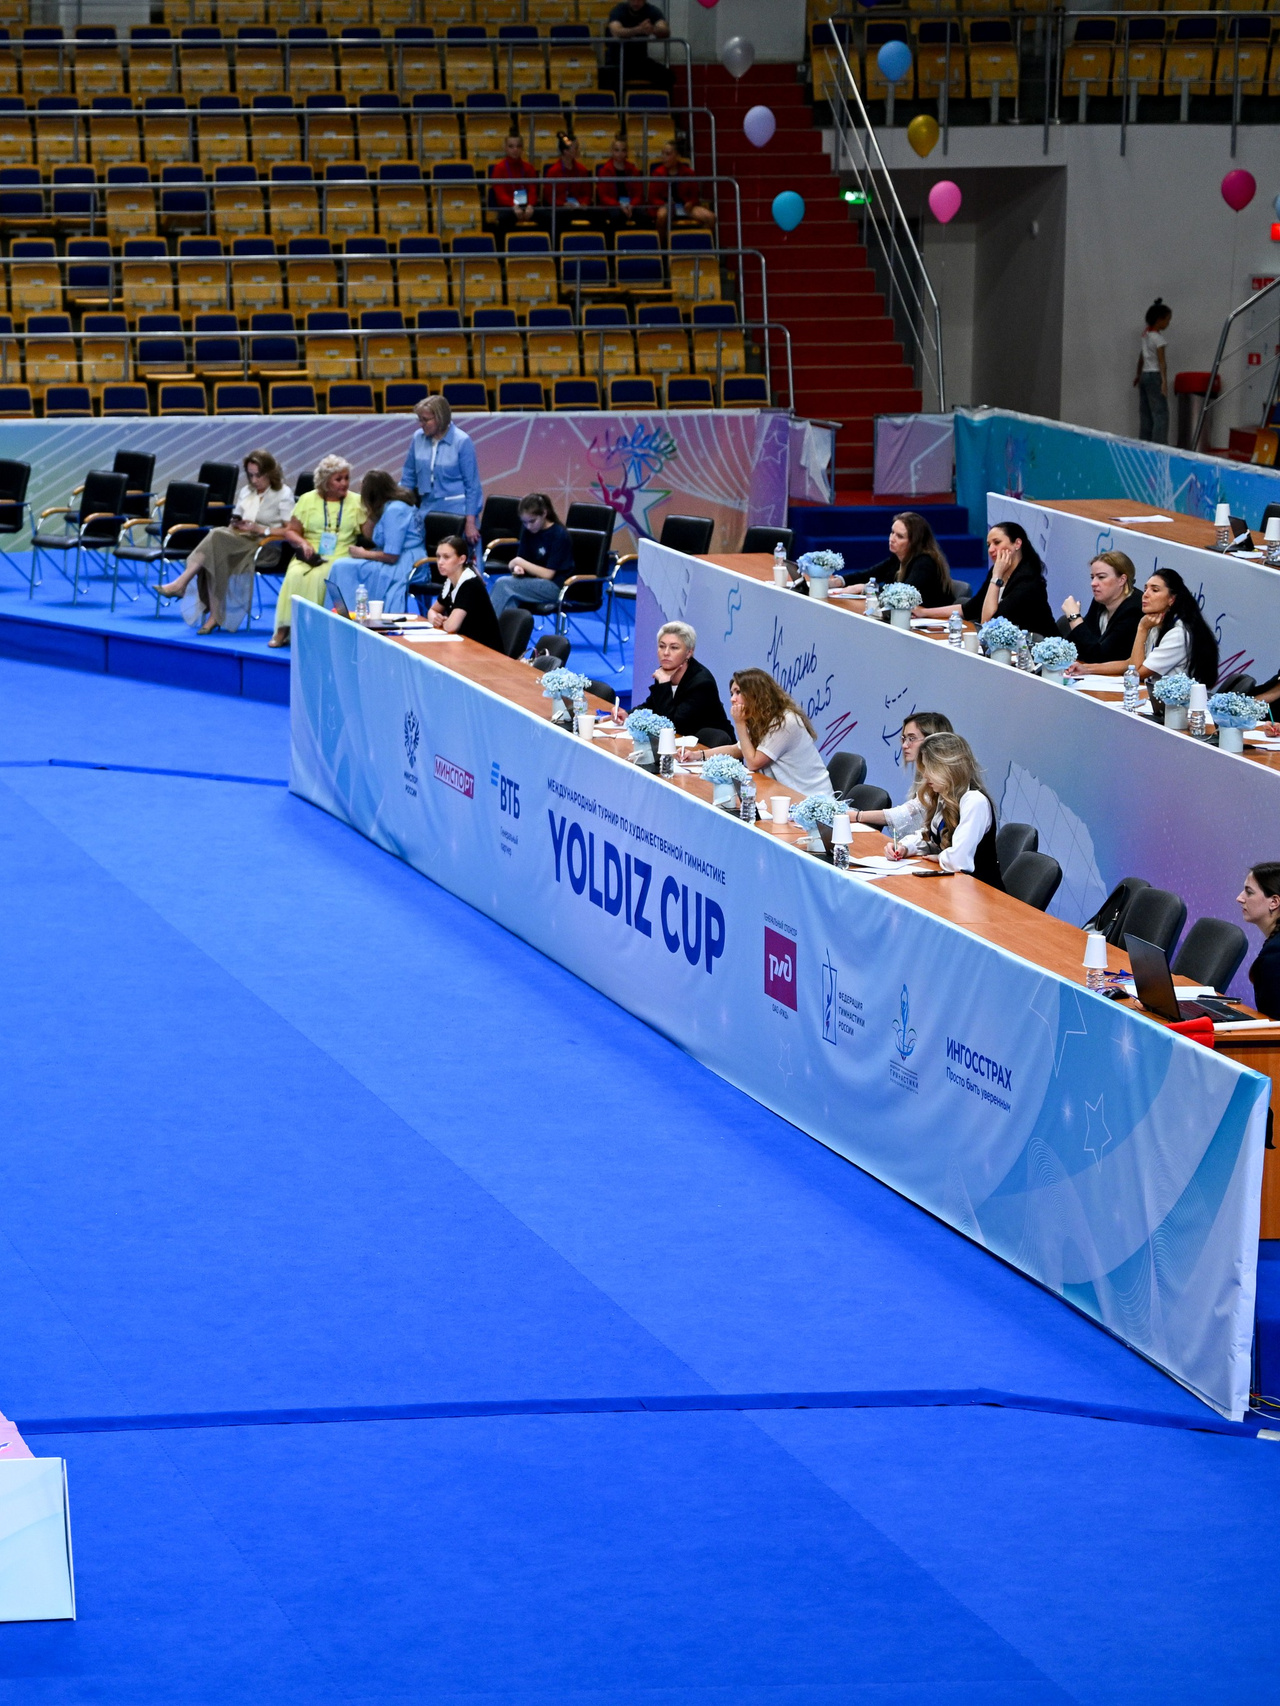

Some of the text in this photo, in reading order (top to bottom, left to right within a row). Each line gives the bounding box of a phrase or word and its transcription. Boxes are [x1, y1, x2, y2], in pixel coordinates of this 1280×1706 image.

[800, 674, 835, 720] 025
[435, 758, 474, 798] МИНСПОРТ
[501, 774, 520, 820] ВТБ
[547, 777, 726, 886] МЕЖДУНАРОДНЫЙ ТУРНИР ПО ХУДОЖЕСТВЕННОЙ ГИМНАСТИКЕ
[548, 808, 726, 975] YOLDIZ CUP
[839, 992, 863, 1011] ФЕДЕРАЦИЯ
[946, 1036, 1012, 1092] ИНГОССТРАХ
[946, 1066, 1012, 1114] Просто быть уверенным
